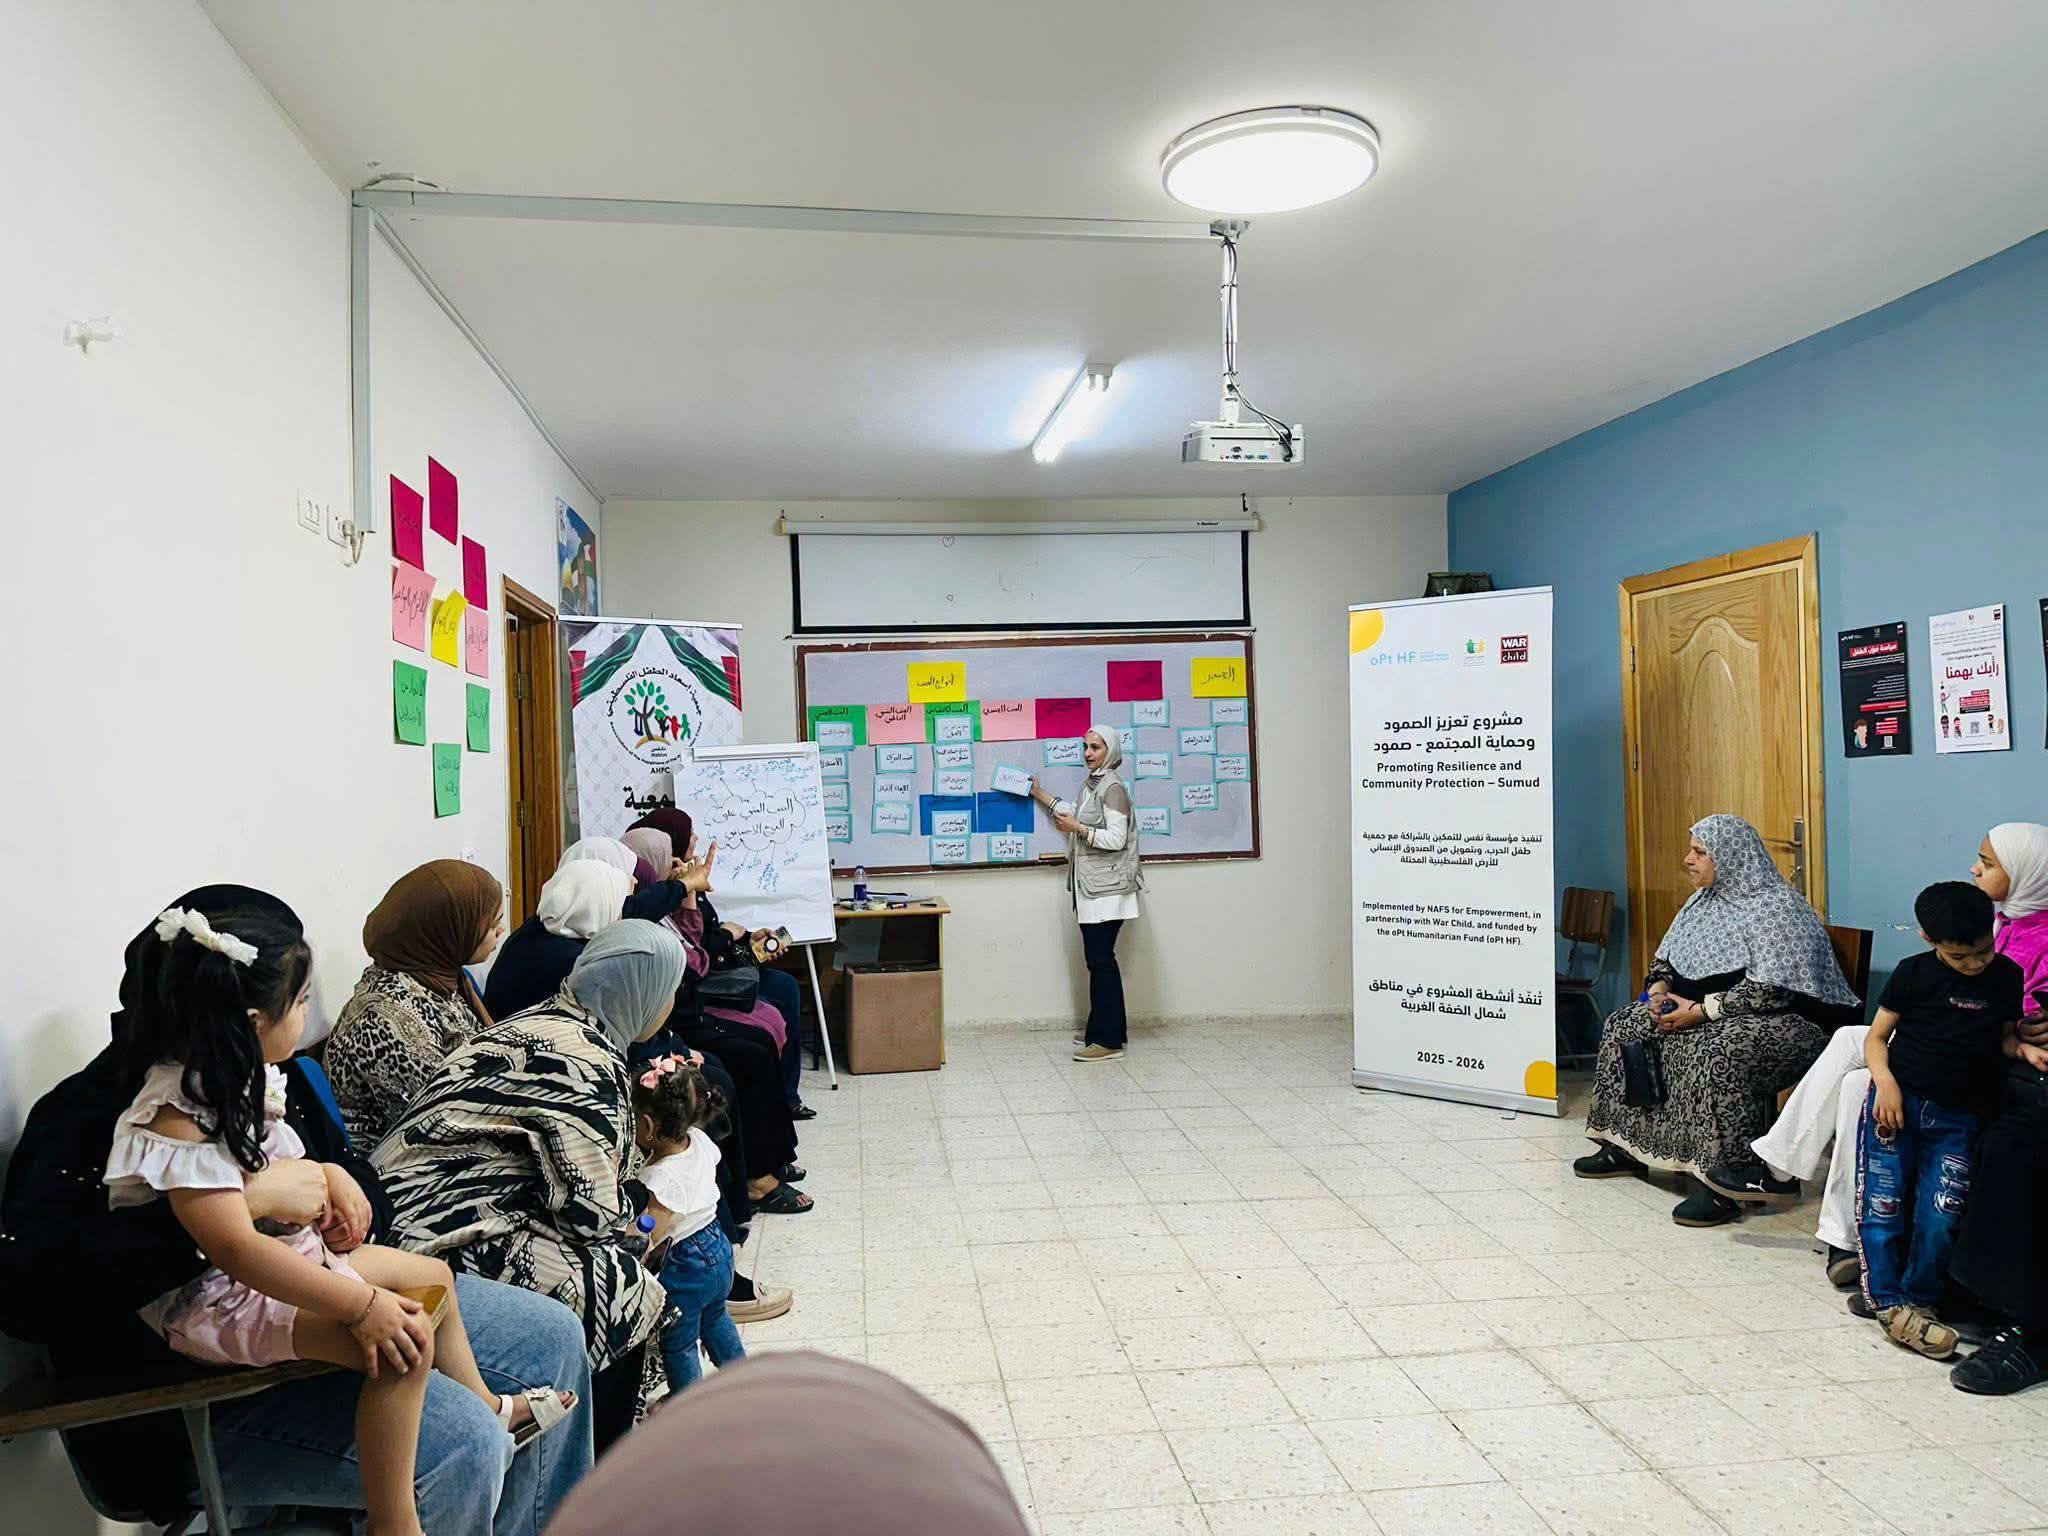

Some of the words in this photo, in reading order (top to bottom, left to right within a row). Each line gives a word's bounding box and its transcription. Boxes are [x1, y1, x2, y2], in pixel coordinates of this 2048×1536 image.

[1502, 638, 1527, 649] WAR
[1397, 651, 1416, 664] HF
[1502, 651, 1527, 662] child
[1977, 656, 1999, 677] رأيك
[1946, 667, 1973, 680] يهمنا
[1384, 716, 1432, 733] الصمود
[1436, 715, 1468, 731] تعزيز
[1473, 711, 1523, 730] مشروع
[1374, 741, 1411, 754] صمود
[1426, 736, 1481, 753] المجتمع
[1486, 735, 1535, 751] وحماية
[1377, 762, 1434, 774] Promoting
[1437, 761, 1496, 771] Resilience
[1499, 760, 1522, 771] and
[1362, 778, 1423, 790] Community
[1425, 777, 1485, 789] Protection
[1498, 777, 1540, 788] Sumud
[623, 786, 676, 817] معية
[1362, 831, 1385, 842] جمعية
[1387, 834, 1398, 842] مع
[1400, 832, 1431, 842] بالشراكة
[1432, 833, 1462, 843] للتمكين
[1464, 834, 1484, 844] نفس
[1486, 833, 1519, 844] مؤسسة
[1521, 834, 1542, 843] تنفيذ
[1369, 844, 1401, 854] الإنساني
[1403, 845, 1434, 854] الصندوق
[1436, 846, 1448, 854] من
[1450, 846, 1482, 855] وبتمويل
[1511, 847, 1531, 857] طفل
[1400, 856, 1427, 864] المحتلة
[1429, 856, 1473, 866] الفلسطينية
[1474, 857, 1498, 868] للأرض
[1362, 902, 1414, 912] Implemented
[1415, 904, 1425, 914] by
[1427, 905, 1450, 914] NAFS
[1451, 906, 1463, 915] for
[1466, 907, 1531, 919] Empowerment,
[1533, 911, 1541, 919] in
[1366, 914, 1412, 926] partnership
[1413, 917, 1431, 926] with
[1432, 918, 1449, 927] War
[1476, 921, 1493, 930] and
[1494, 921, 1525, 932] funded
[1526, 924, 1537, 934] by
[1377, 928, 1390, 936] the
[1391, 929, 1405, 937] oPt
[1406, 929, 1462, 941] Humanitarian
[1463, 933, 1484, 943] Fund
[1486, 934, 1504, 944] (oPt
[1368, 979, 1403, 992] مناطق
[1406, 984, 1423, 997] في
[1426, 984, 1472, 999] المشروع
[1476, 988, 1515, 1003] أنشطة
[1400, 999, 1435, 1013] الغربية
[1438, 1003, 1471, 1016] الضفة
[1474, 1007, 1506, 1020] شمال
[1417, 1051, 1445, 1065] 2025
[1456, 1056, 1485, 1070] 2026
